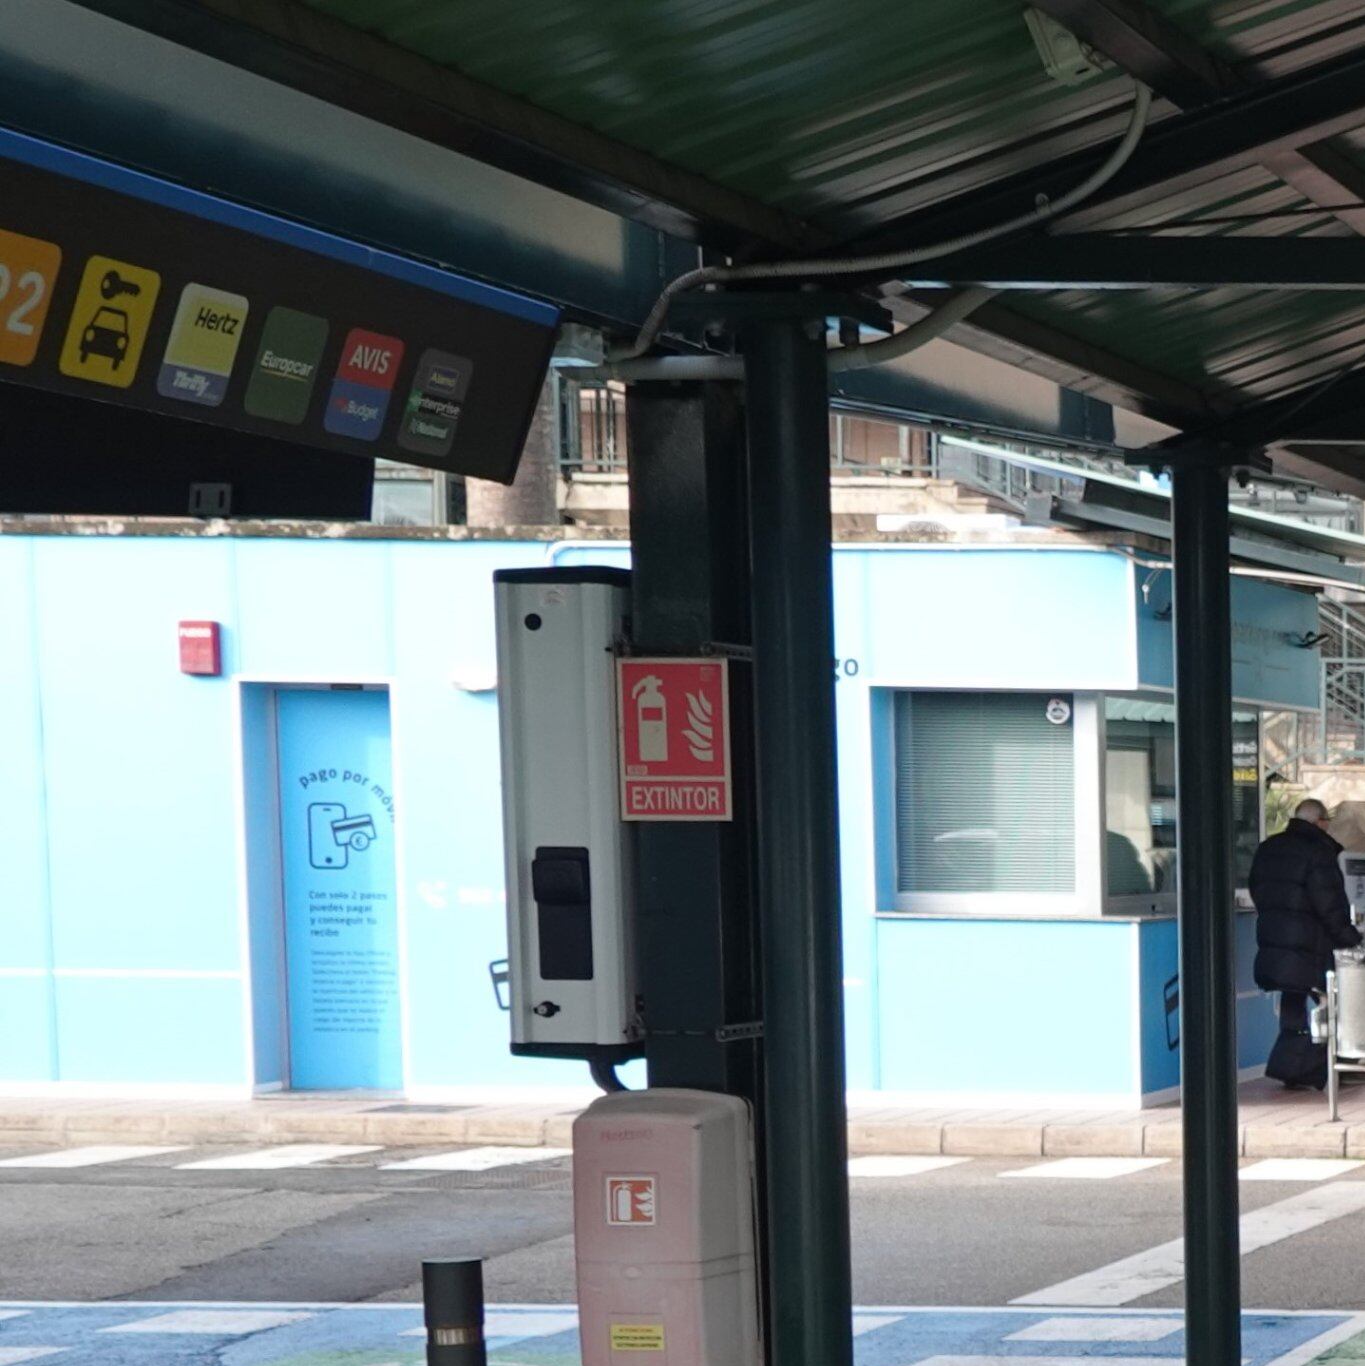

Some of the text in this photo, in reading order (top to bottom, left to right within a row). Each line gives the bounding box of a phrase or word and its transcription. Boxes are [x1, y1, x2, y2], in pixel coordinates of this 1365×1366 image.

[194, 307, 240, 336] Hertz
[260, 350, 315, 377] Europcar
[349, 345, 392, 375] AVIS
[347, 401, 379, 422] Budget
[299, 769, 337, 790] pago
[342, 770, 369, 786] por
[632, 786, 720, 811] EXTINTOR
